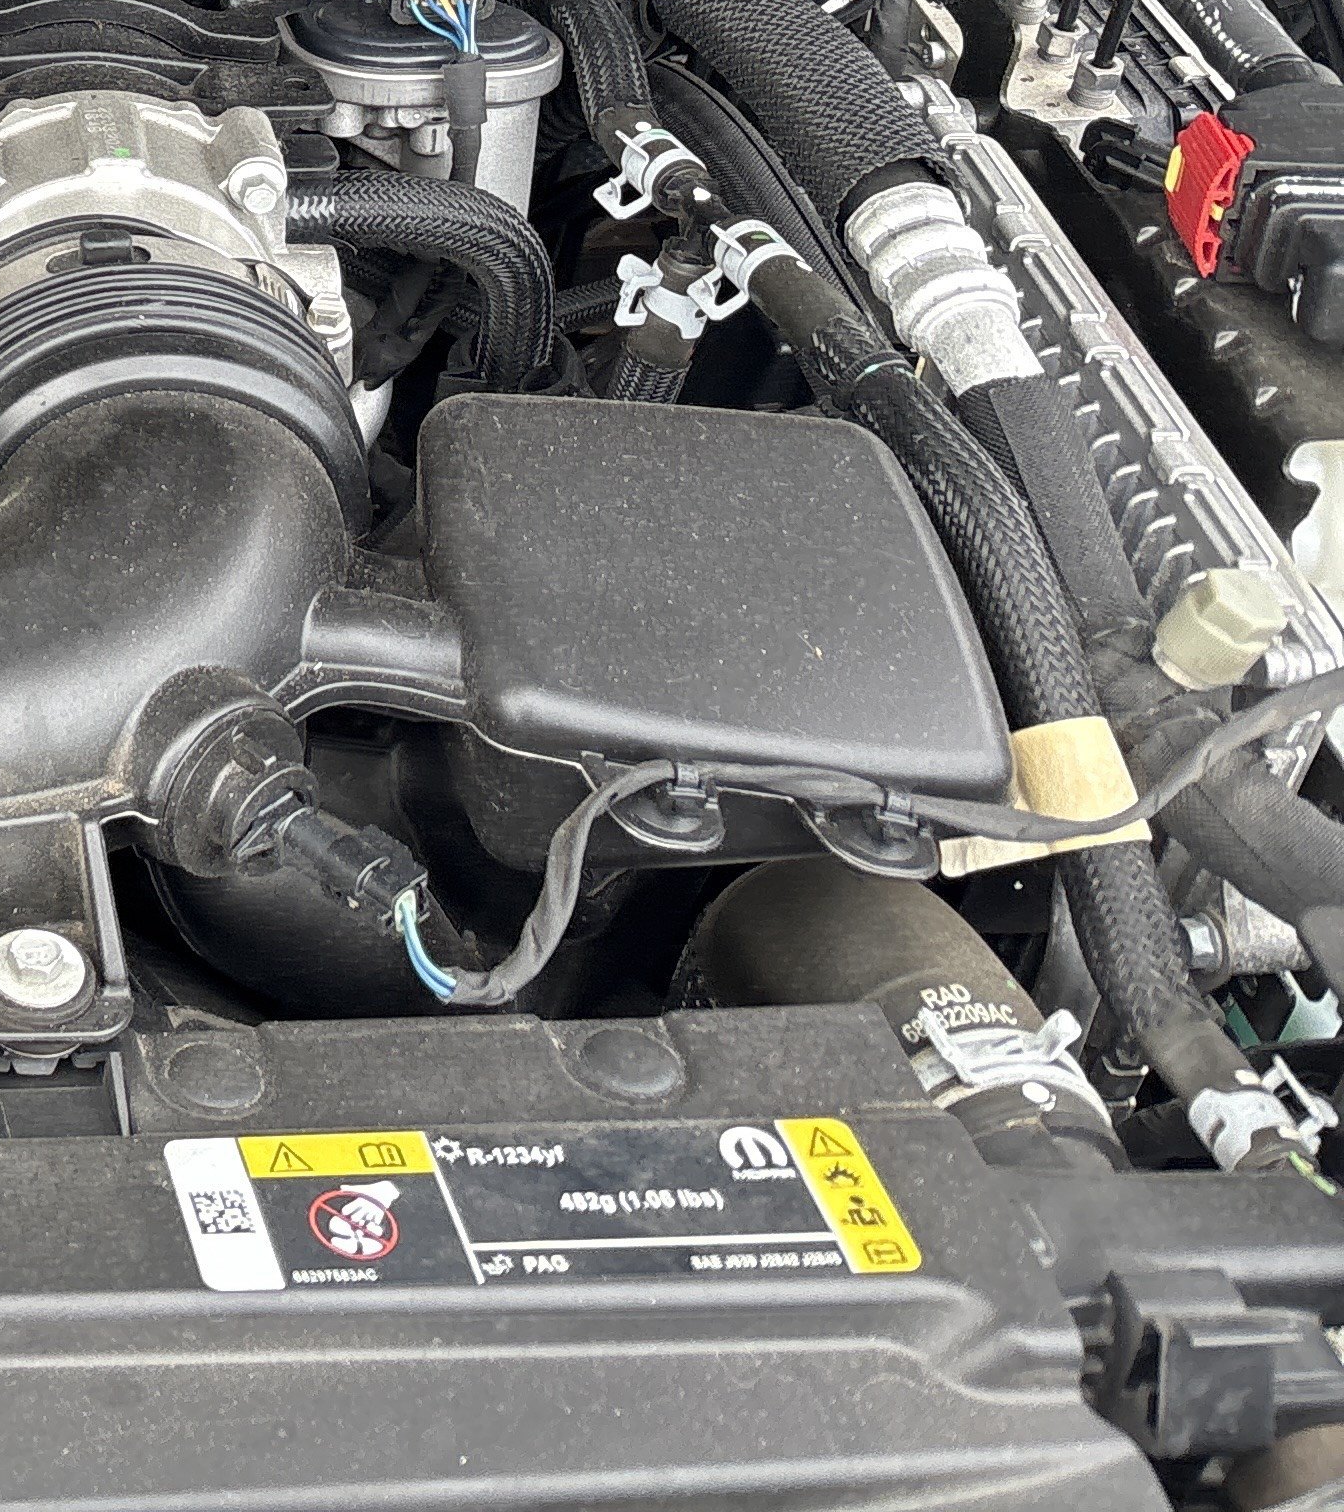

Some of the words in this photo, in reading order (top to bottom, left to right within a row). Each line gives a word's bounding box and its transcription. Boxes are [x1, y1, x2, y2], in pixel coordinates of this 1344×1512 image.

[920, 984, 972, 1009] RAD
[901, 1003, 1018, 1043] 6882209AC
[466, 1144, 565, 1169] R-1234yf
